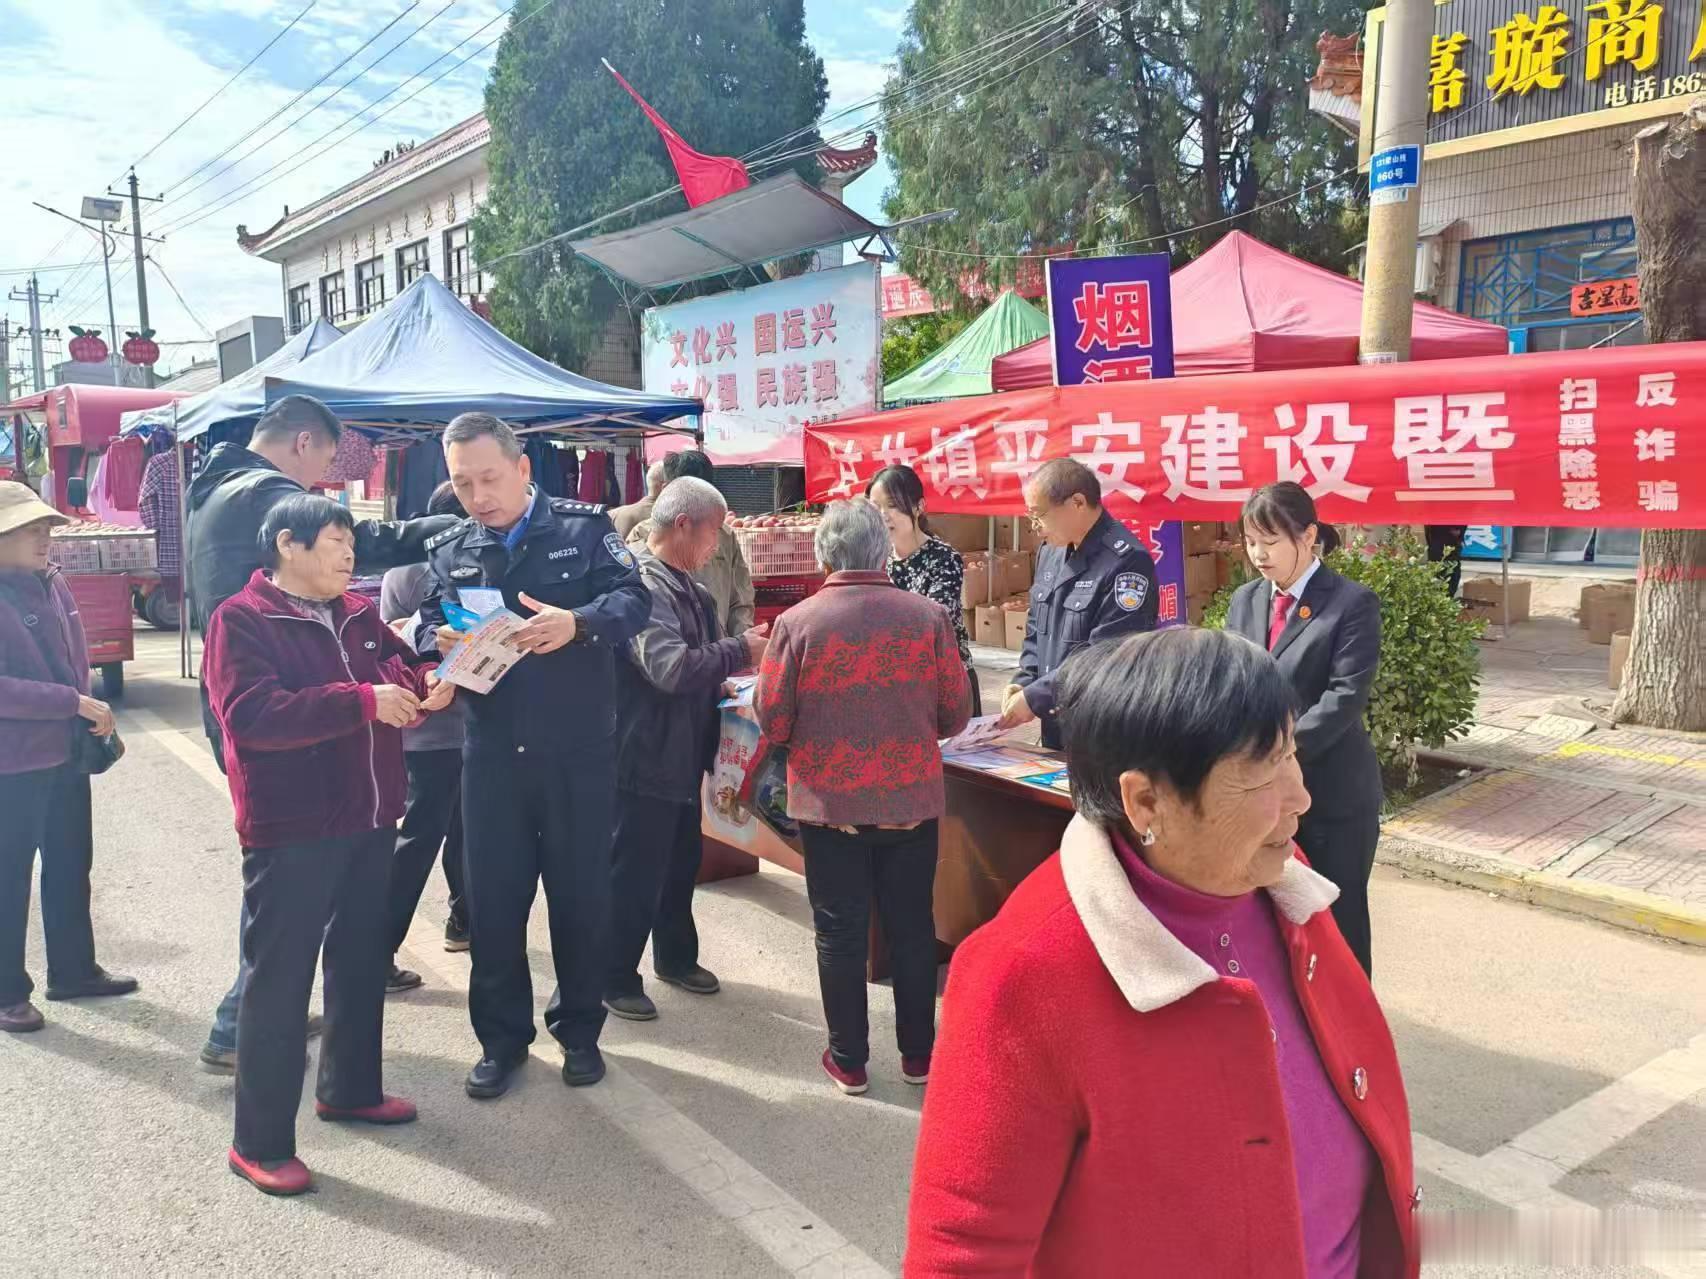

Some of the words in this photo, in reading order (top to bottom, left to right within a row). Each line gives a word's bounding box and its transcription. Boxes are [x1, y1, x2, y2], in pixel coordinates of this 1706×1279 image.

[1604, 75, 1657, 107] 电话
[1660, 72, 1706, 99] 186
[669, 319, 737, 368] 文化兴
[754, 303, 837, 356] 国运兴
[756, 360, 839, 408] 民族强
[1558, 378, 1601, 511] 扫黑除恶
[1633, 371, 1679, 512] 反诈骗
